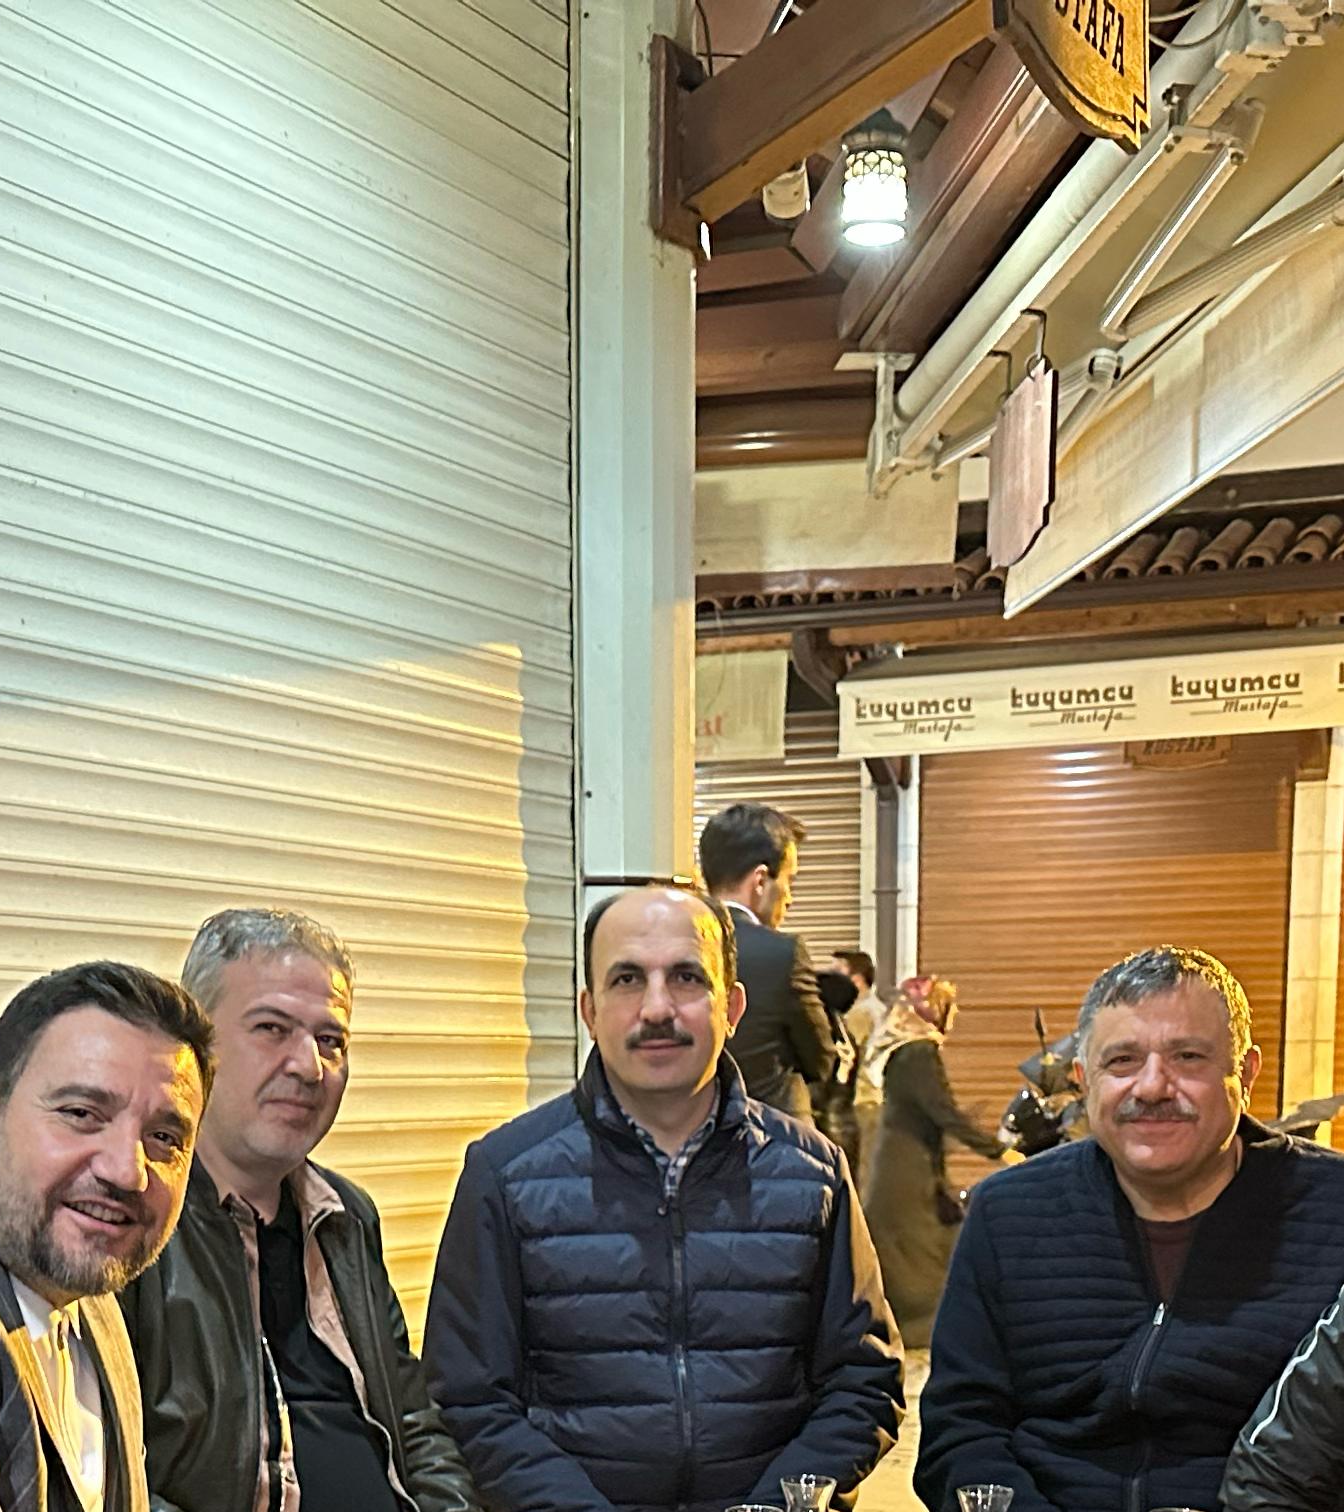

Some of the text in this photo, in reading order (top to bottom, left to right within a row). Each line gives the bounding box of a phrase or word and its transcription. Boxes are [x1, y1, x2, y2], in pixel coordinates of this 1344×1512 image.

[1171, 672, 1300, 699] kuyumcu
[856, 697, 972, 721] kuyumcu
[1011, 685, 1133, 711] kuyumcu
[1222, 696, 1289, 720] Mustafa
[902, 719, 962, 742] Mustafa
[1060, 708, 1123, 732] Mustafa
